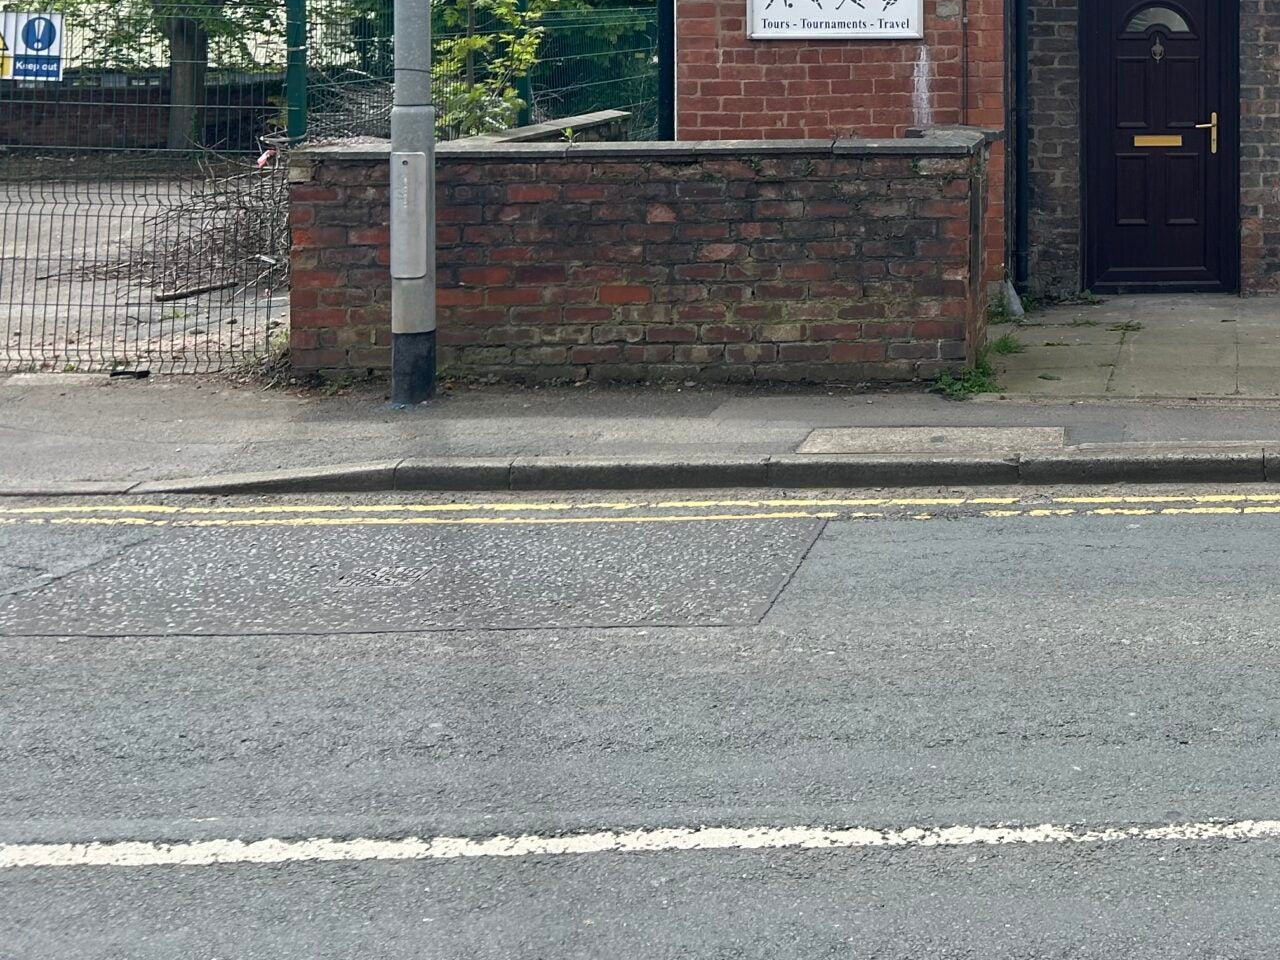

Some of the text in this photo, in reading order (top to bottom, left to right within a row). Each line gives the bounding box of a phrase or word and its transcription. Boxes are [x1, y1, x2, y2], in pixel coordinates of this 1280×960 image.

[761, 18, 790, 30] Tours
[800, 18, 867, 30] Tournaments
[877, 18, 910, 30] Travel
[41, 62, 58, 71] out
